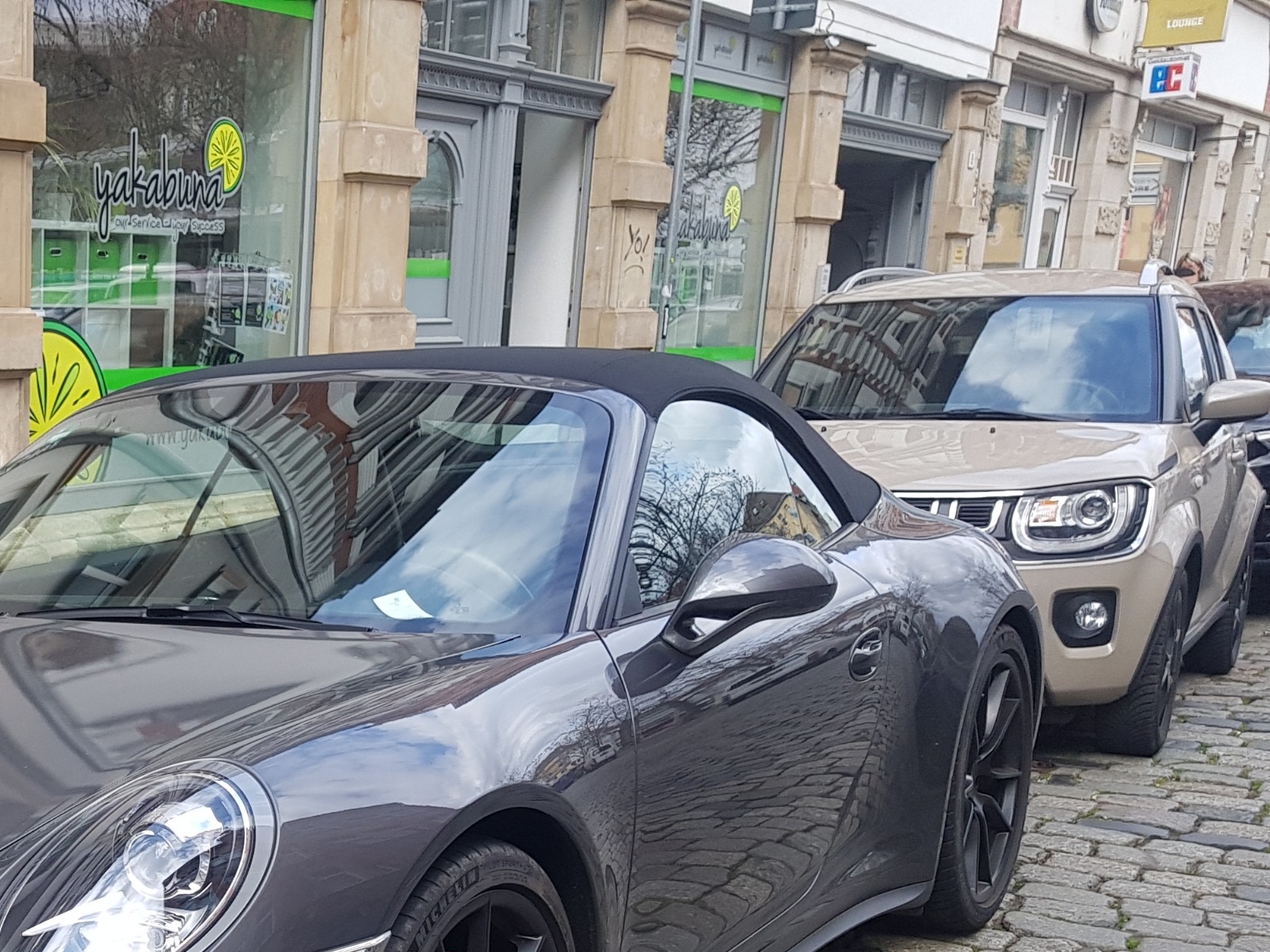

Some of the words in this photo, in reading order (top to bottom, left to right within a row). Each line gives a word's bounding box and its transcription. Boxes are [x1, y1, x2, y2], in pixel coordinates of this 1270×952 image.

[1166, 16, 1205, 29] LOUNGE
[95, 130, 225, 241] yakabuna
[115, 217, 129, 230] our
[171, 219, 189, 243] your
[414, 867, 479, 950] MICHELIN
